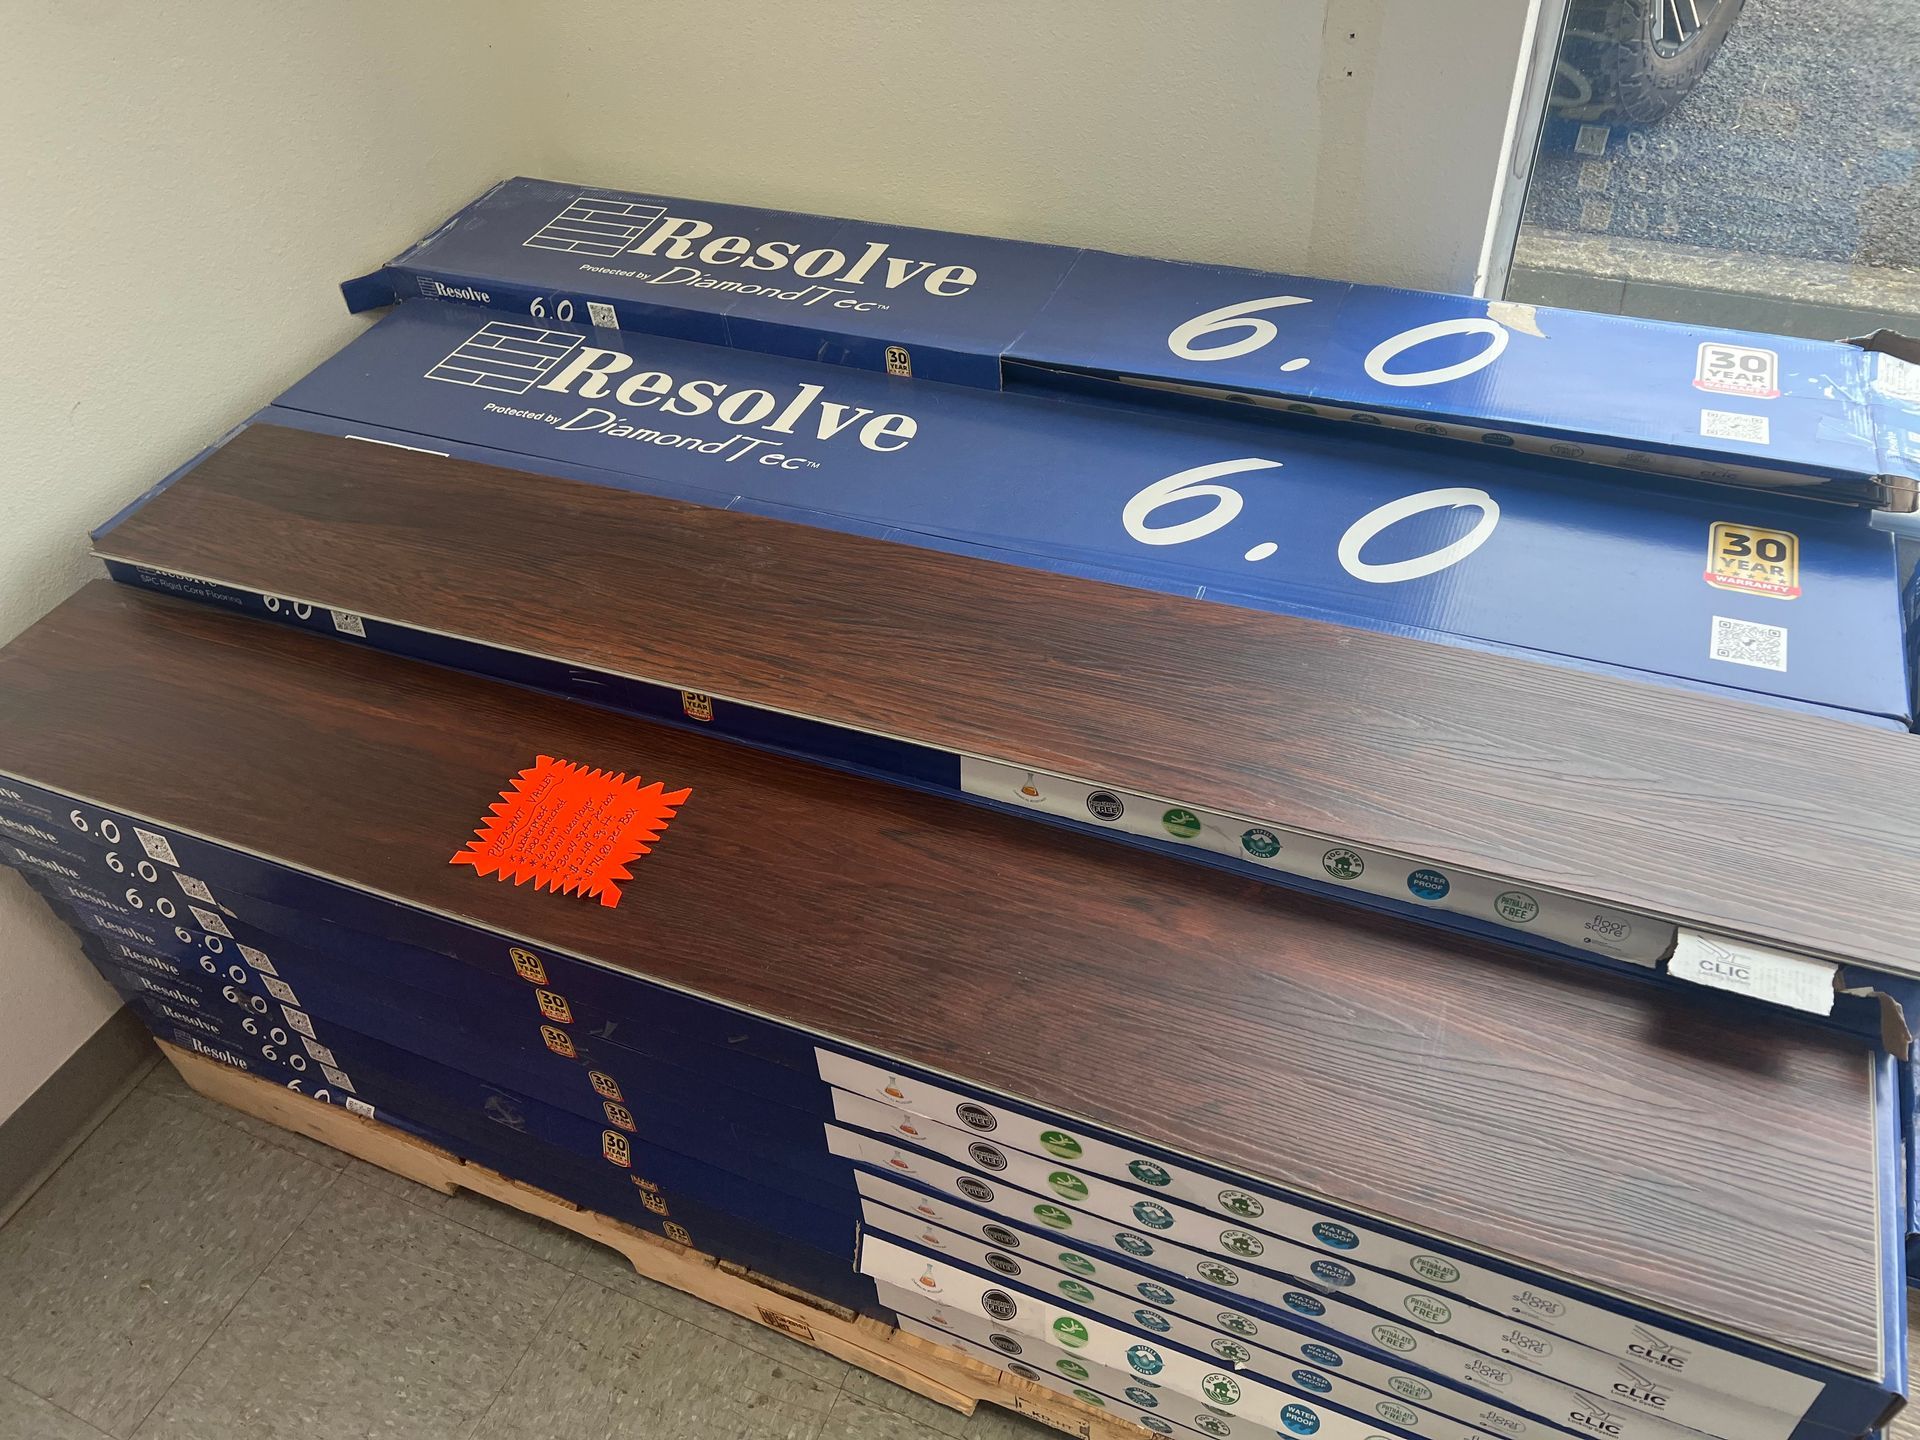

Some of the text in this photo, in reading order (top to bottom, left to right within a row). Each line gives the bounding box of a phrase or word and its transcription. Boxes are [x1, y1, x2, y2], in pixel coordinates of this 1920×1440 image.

[627, 216, 977, 297] Resolve
[579, 264, 636, 277] Protected
[636, 270, 651, 280] by
[434, 281, 491, 303] Resolve
[529, 296, 574, 322] 6.0
[1167, 295, 1511, 388] 6.0
[888, 350, 907, 365] 30
[1710, 350, 1767, 374] 30
[890, 363, 908, 372] YEAR
[1707, 369, 1766, 383] YEAR
[537, 346, 918, 452] Resolve
[483, 402, 546, 421] Protected
[544, 415, 562, 425] by
[1122, 457, 1501, 584] 6.0
[1722, 531, 1787, 563] 30
[1719, 557, 1785, 577] YEAR
[140, 574, 160, 585] SPC
[183, 584, 204, 596] Core
[1715, 575, 1790, 593] WARRANTY
[687, 700, 708, 711] YEAR
[487, 773, 555, 857] PHEASANT VALLEY
[70, 810, 121, 844] 6.0
[524, 799, 566, 855] pad attached
[606, 826, 622, 844] per
[16, 847, 80, 880] Resolve
[545, 850, 557, 862] 20
[1326, 850, 1361, 868] VOC FREE
[105, 851, 158, 883] 6.0
[1413, 880, 1443, 890] PROOF
[1415, 872, 1446, 884] WATER
[125, 888, 176, 919] 6.0
[1500, 896, 1535, 912] PHTHALATE
[1502, 906, 1528, 919] FREE
[94, 914, 156, 946] Resolve
[1584, 921, 1623, 938] score
[1593, 914, 1627, 932] floor
[174, 926, 224, 954] 6.0
[120, 943, 180, 976] Resolve
[514, 951, 539, 969] 30
[200, 955, 247, 984] 6.0
[518, 963, 542, 975] YEAR
[1699, 959, 1750, 980] CLIC
[140, 976, 201, 1008] Resolve
[222, 985, 268, 1014] 6.0
[540, 990, 565, 1008] 30
[544, 1004, 567, 1014] YEAR
[162, 1004, 221, 1035] Resolve
[241, 1017, 288, 1046] 6.0
[545, 1028, 568, 1044] 30
[192, 1037, 248, 1070] Resolve
[261, 1044, 307, 1072] 6.0
[593, 1074, 615, 1090] 30
[607, 1104, 629, 1120] 30
[606, 1133, 626, 1151] 30
[606, 1146, 627, 1158] YEAR
[1318, 1229, 1353, 1242] PROOF
[1320, 1222, 1355, 1238] WATER
[1316, 1266, 1348, 1280] PROOF
[1318, 1261, 1351, 1276] WATER
[1416, 1258, 1454, 1276] PHTHALATE
[1419, 1266, 1447, 1280] FREE
[988, 1303, 1011, 1313] FREE
[1288, 1297, 1319, 1311] PROOF
[1290, 1292, 1322, 1307] WATER
[1410, 1297, 1447, 1316] PHTHALATE
[1512, 1294, 1556, 1314] score
[1522, 1290, 1560, 1310] floor
[1412, 1305, 1439, 1321] FREE
[1377, 1327, 1412, 1345] PHTHALATE
[1379, 1334, 1405, 1350] FREE
[1501, 1334, 1544, 1354] score
[1511, 1329, 1548, 1349] floor
[1306, 1349, 1336, 1362] PROOF
[1308, 1345, 1338, 1358] WATER
[1628, 1343, 1685, 1368] CLIC
[1205, 1375, 1239, 1395] VOC FREE
[1297, 1375, 1327, 1388] PROOF
[1298, 1370, 1328, 1384] WATER
[1613, 1382, 1667, 1406] CLIC
[1286, 1412, 1315, 1426] PROOF
[1288, 1405, 1317, 1421] WATER
[1569, 1411, 1621, 1435] CLIC
